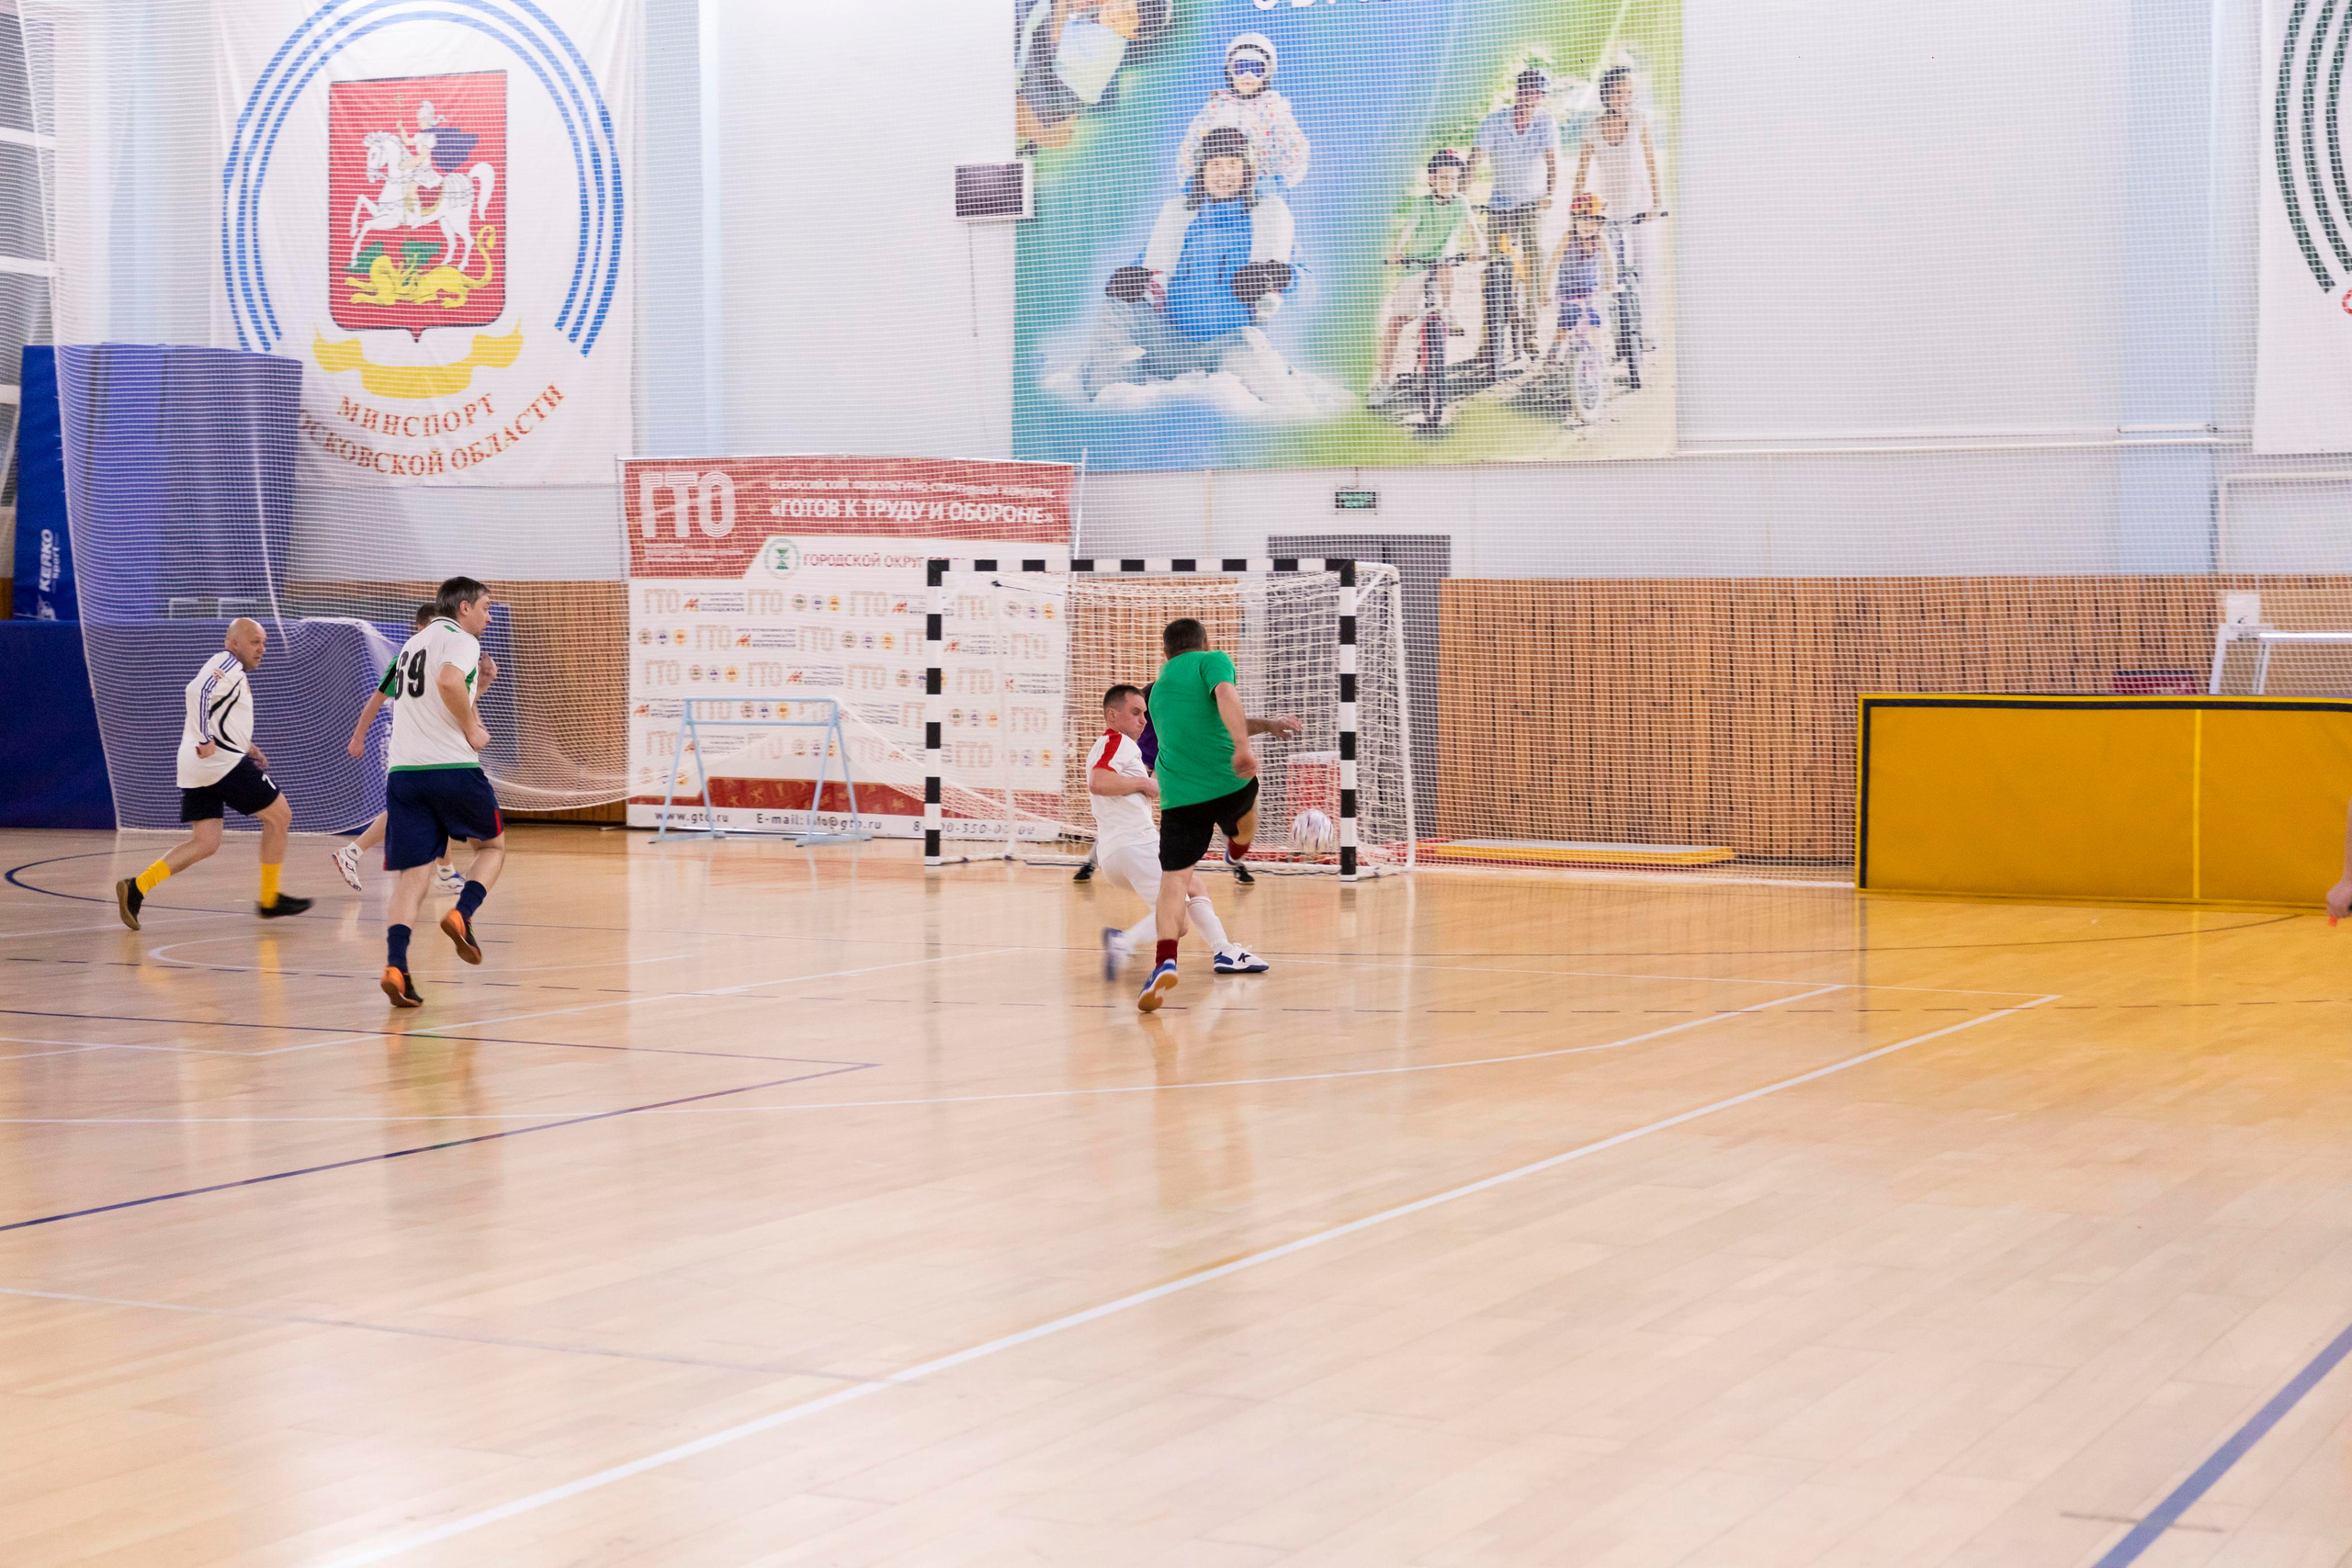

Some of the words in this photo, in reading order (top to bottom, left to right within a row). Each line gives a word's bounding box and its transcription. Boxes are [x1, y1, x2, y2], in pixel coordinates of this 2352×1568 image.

[300, 409, 447, 476] ОСКОВСКОЙ
[450, 381, 566, 470] ОБЛАСТИ
[336, 393, 495, 437] МИНСПОРТ
[639, 471, 736, 538] ГТО
[770, 498, 840, 517] «ГОТОВ
[844, 499, 858, 517] К
[863, 500, 925, 522] ТРУДУ
[929, 502, 944, 520] И
[949, 502, 1055, 524] ОБОРОНЕ»
[802, 552, 881, 568] ГОРОДСКОЙ
[884, 555, 924, 569] ОКРУГ
[904, 628, 927, 656] ГТ
[902, 702, 926, 728] ГТ
[756, 813, 804, 826] E-mail:
